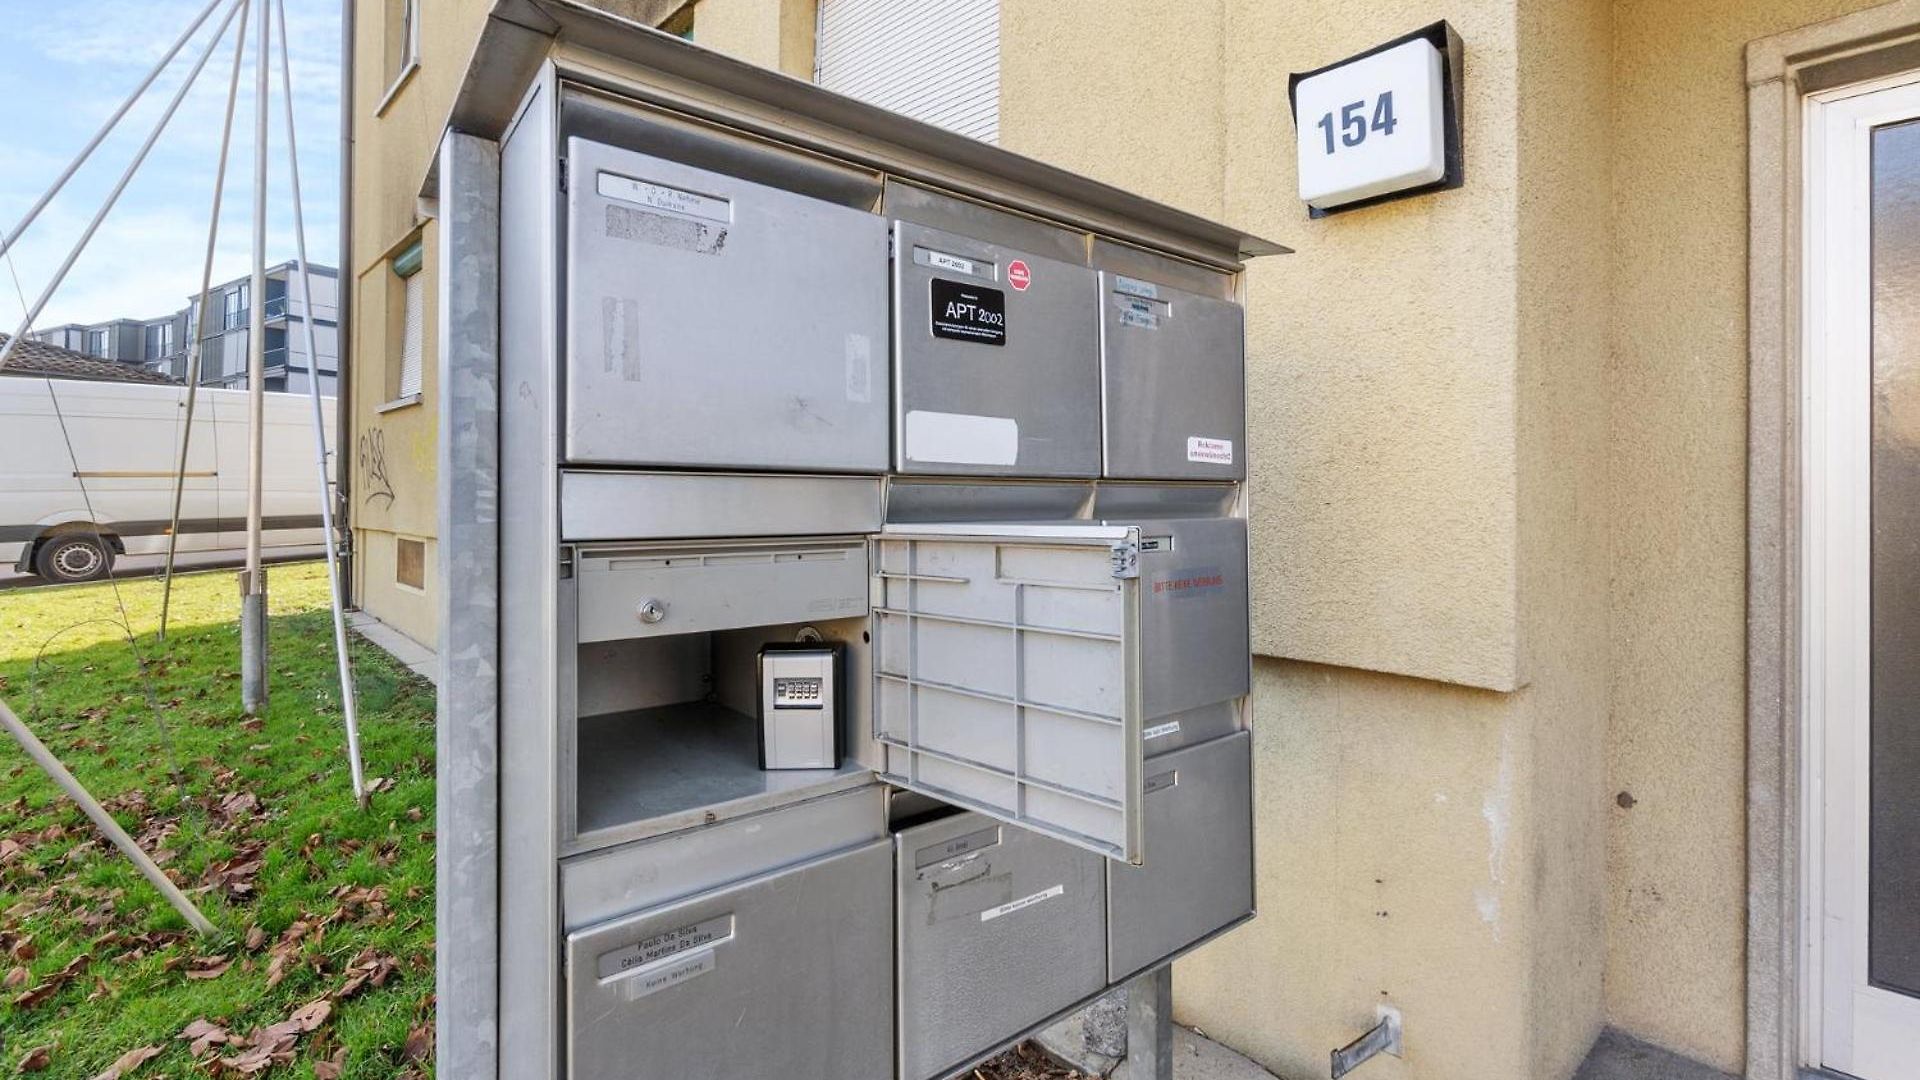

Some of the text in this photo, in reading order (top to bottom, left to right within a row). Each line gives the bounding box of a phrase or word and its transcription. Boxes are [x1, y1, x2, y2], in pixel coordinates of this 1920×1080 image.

[1318, 90, 1397, 155] 154
[945, 301, 1004, 326] APT 2002
[637, 926, 697, 951] Paulo Da Silva
[680, 939, 690, 949] Da
[693, 933, 712, 944] Silva
